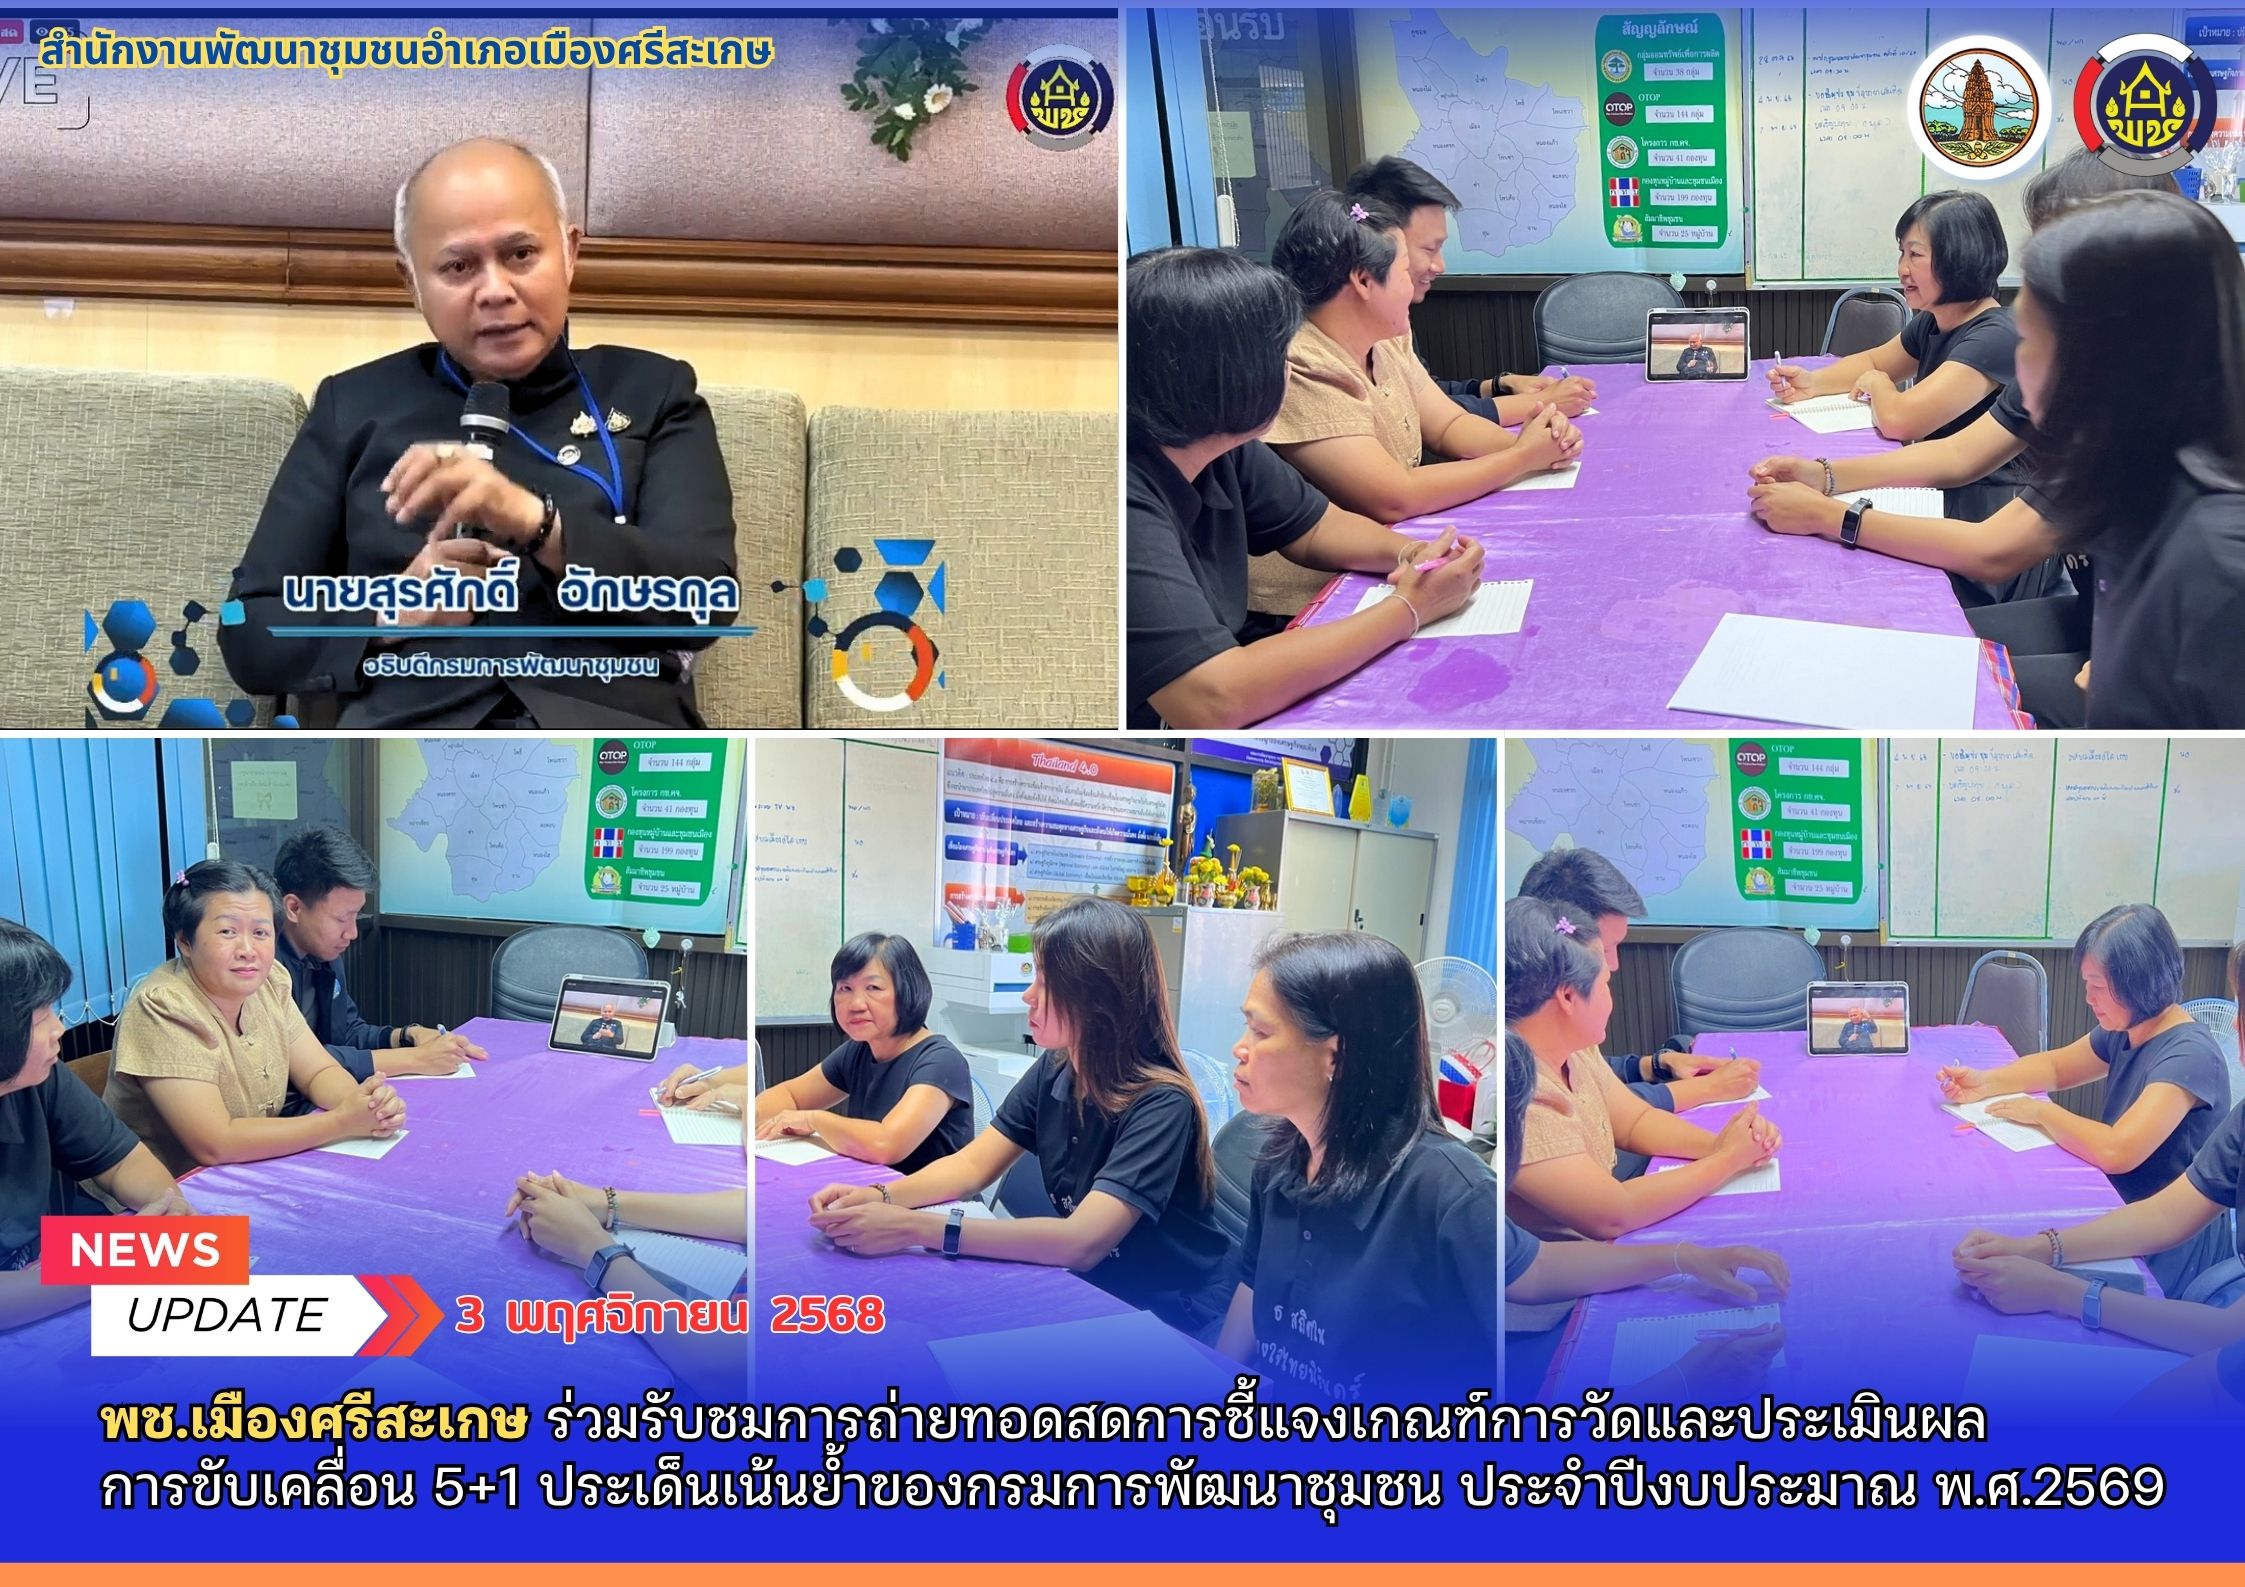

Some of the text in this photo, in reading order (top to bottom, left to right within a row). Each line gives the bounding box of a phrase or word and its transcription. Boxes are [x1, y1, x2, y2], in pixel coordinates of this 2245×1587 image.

[2199, 25, 2230, 38] เป้าหมาย
[1605, 103, 1633, 112] OTOP
[633, 741, 657, 749] OTOP
[1771, 744, 1795, 753] OTOP
[599, 751, 627, 760] OTOP
[1736, 752, 1766, 762] OTOP
[1031, 752, 1099, 777] Thailand 4.0
